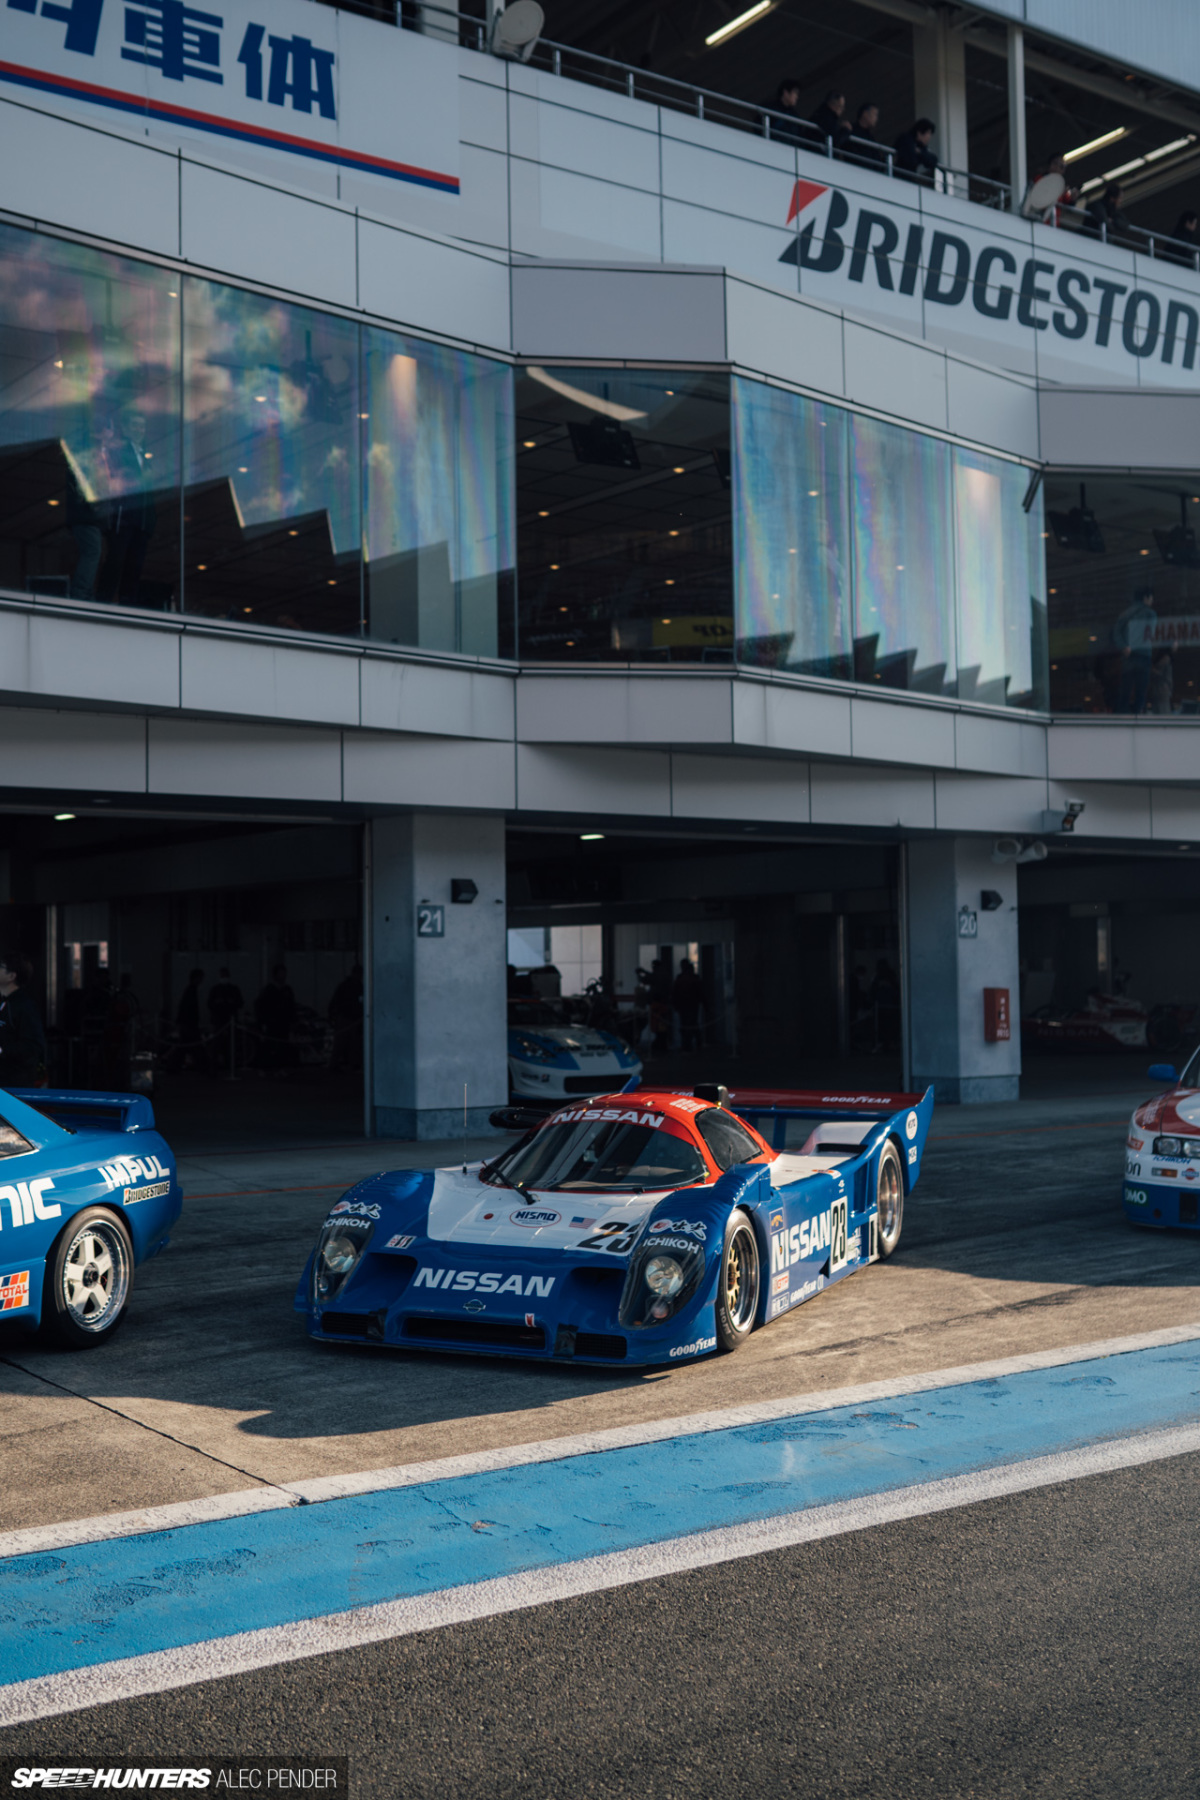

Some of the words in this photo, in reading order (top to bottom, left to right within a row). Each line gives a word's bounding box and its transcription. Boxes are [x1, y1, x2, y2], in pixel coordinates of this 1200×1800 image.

[419, 909, 442, 933] 21
[959, 914, 977, 935] 20
[551, 1109, 665, 1129] NISSAN
[98, 1155, 171, 1191] IMPUL
[125, 1181, 170, 1204] BRIDGESTONE
[514, 1210, 558, 1222] NISMO
[771, 1209, 832, 1275] NISSAN
[832, 1202, 846, 1266] 23
[642, 1236, 700, 1255] ICHIKOH
[0, 1284, 28, 1299] TOTAL
[413, 1267, 556, 1298] NISSAN
[669, 1336, 717, 1358] GOODYEAR
